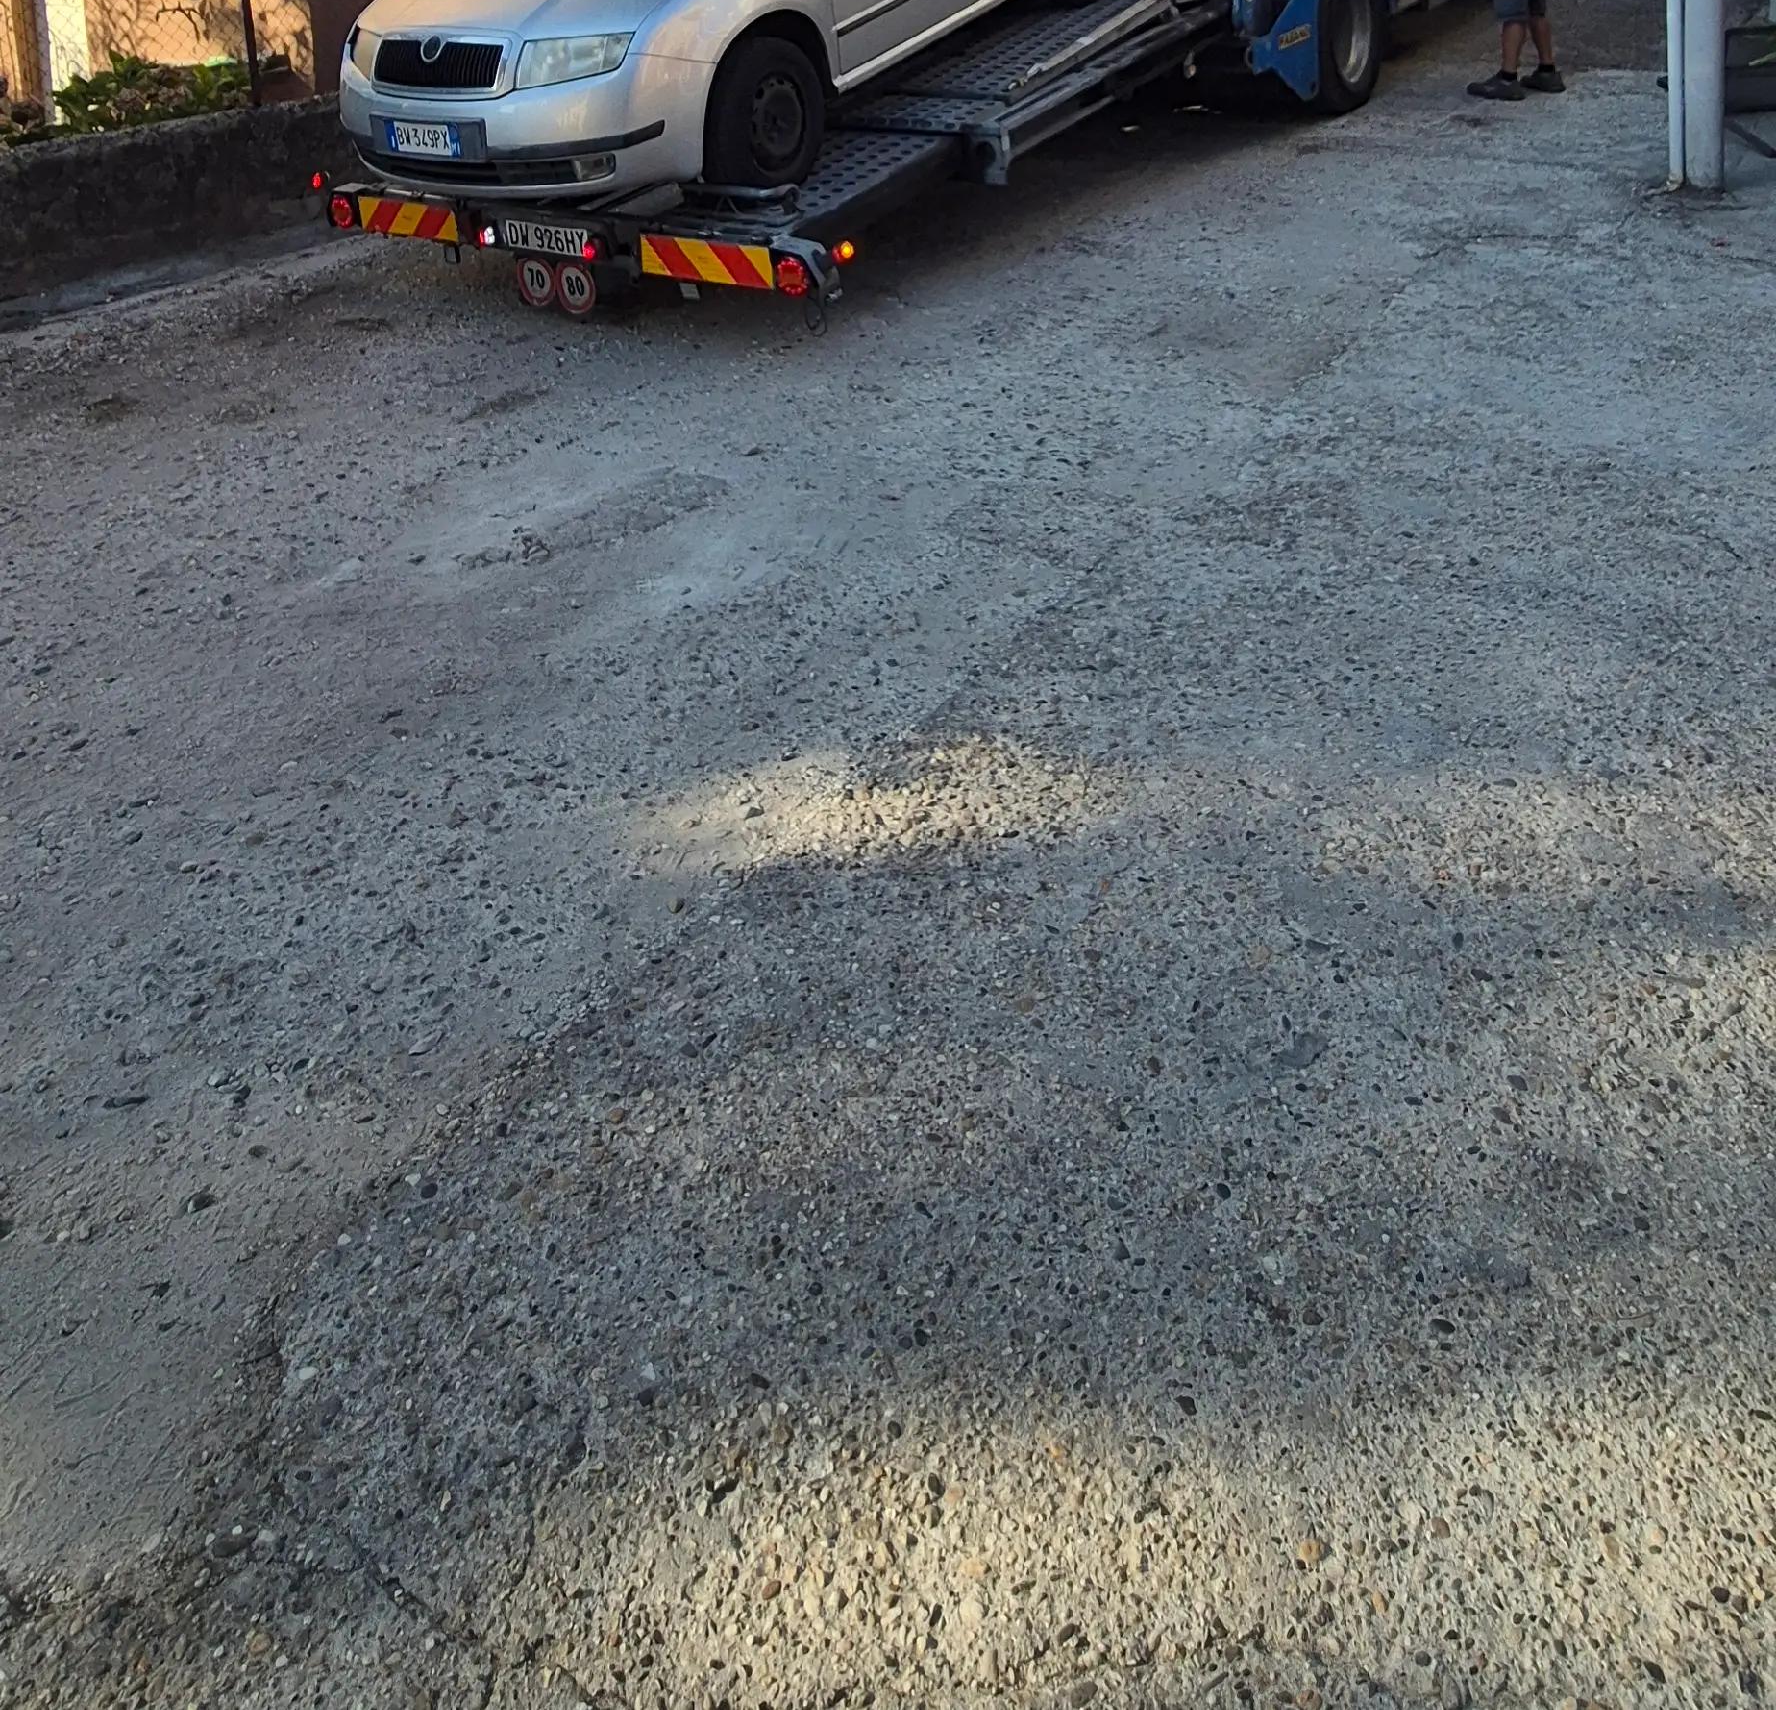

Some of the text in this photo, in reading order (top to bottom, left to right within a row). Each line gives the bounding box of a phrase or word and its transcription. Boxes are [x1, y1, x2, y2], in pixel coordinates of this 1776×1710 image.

[412, 128, 450, 150] 349PX
[508, 223, 584, 255] DW 926HY
[527, 267, 546, 289] 70
[566, 275, 585, 297] 80
